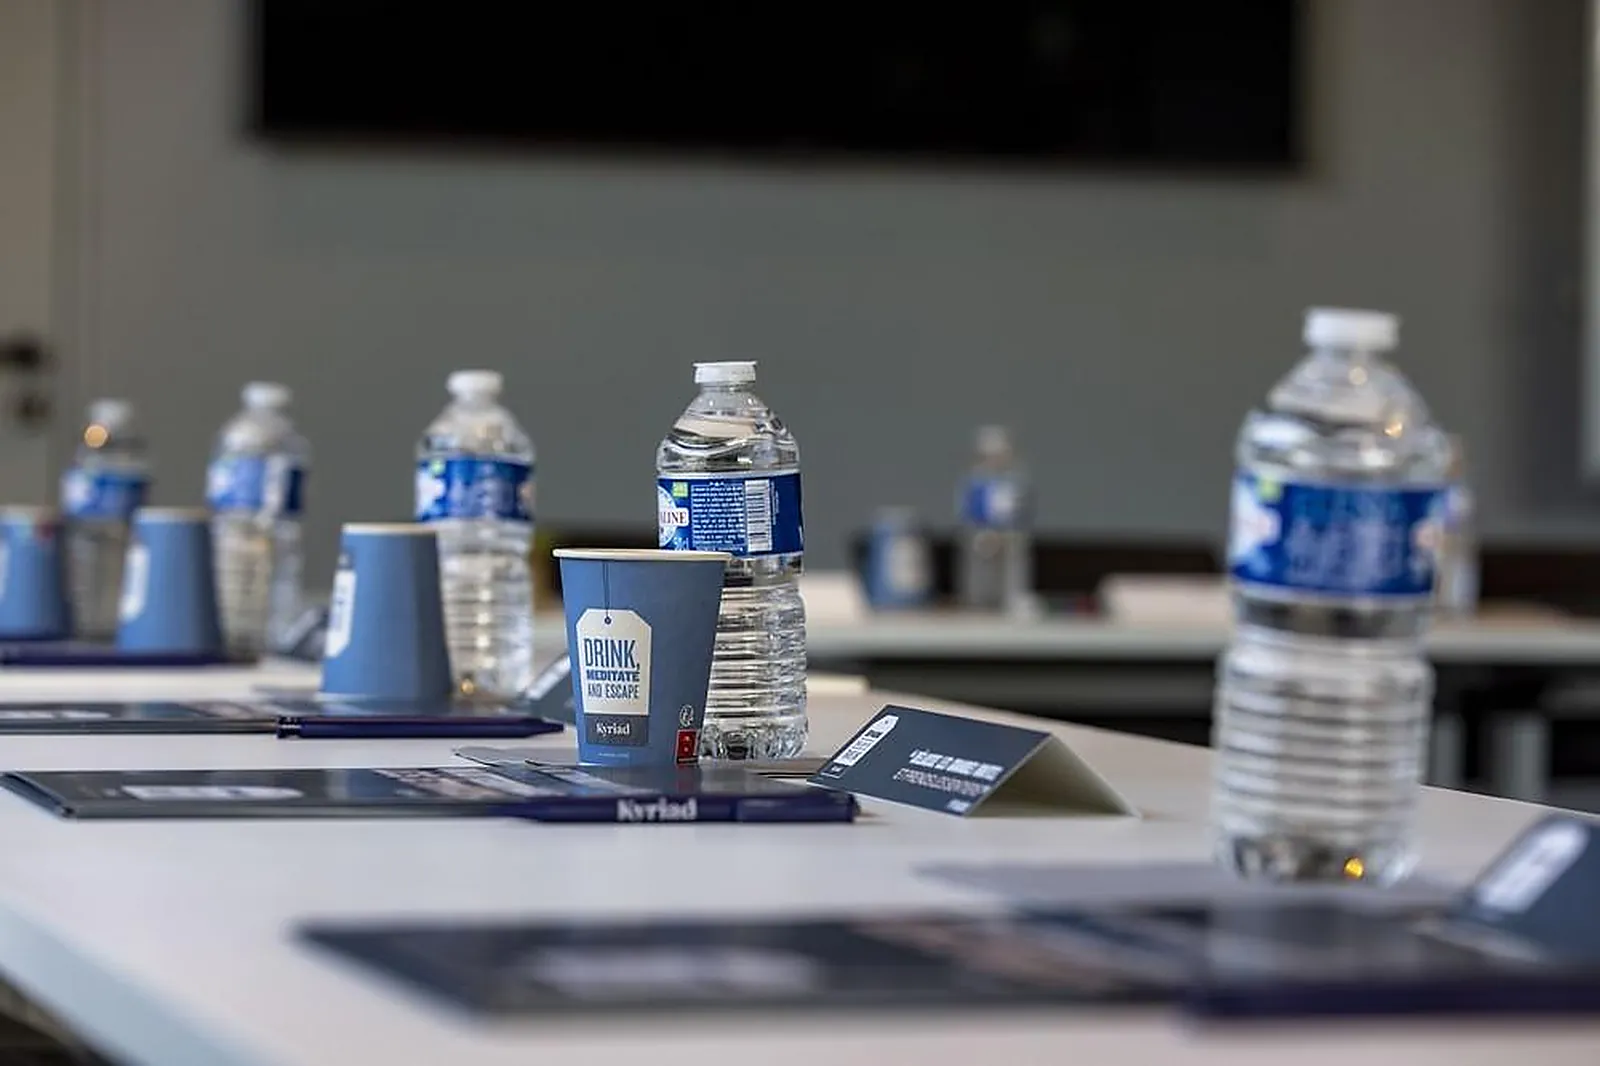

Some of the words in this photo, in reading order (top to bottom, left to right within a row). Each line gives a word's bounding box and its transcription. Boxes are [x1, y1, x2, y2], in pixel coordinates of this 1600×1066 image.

[584, 638, 640, 671] DRINK,
[586, 669, 640, 682] MEDITATE
[588, 683, 602, 698] AND
[605, 683, 640, 699] ESCAPE
[596, 722, 630, 738] Kyriad
[617, 797, 697, 821] Kyriad
